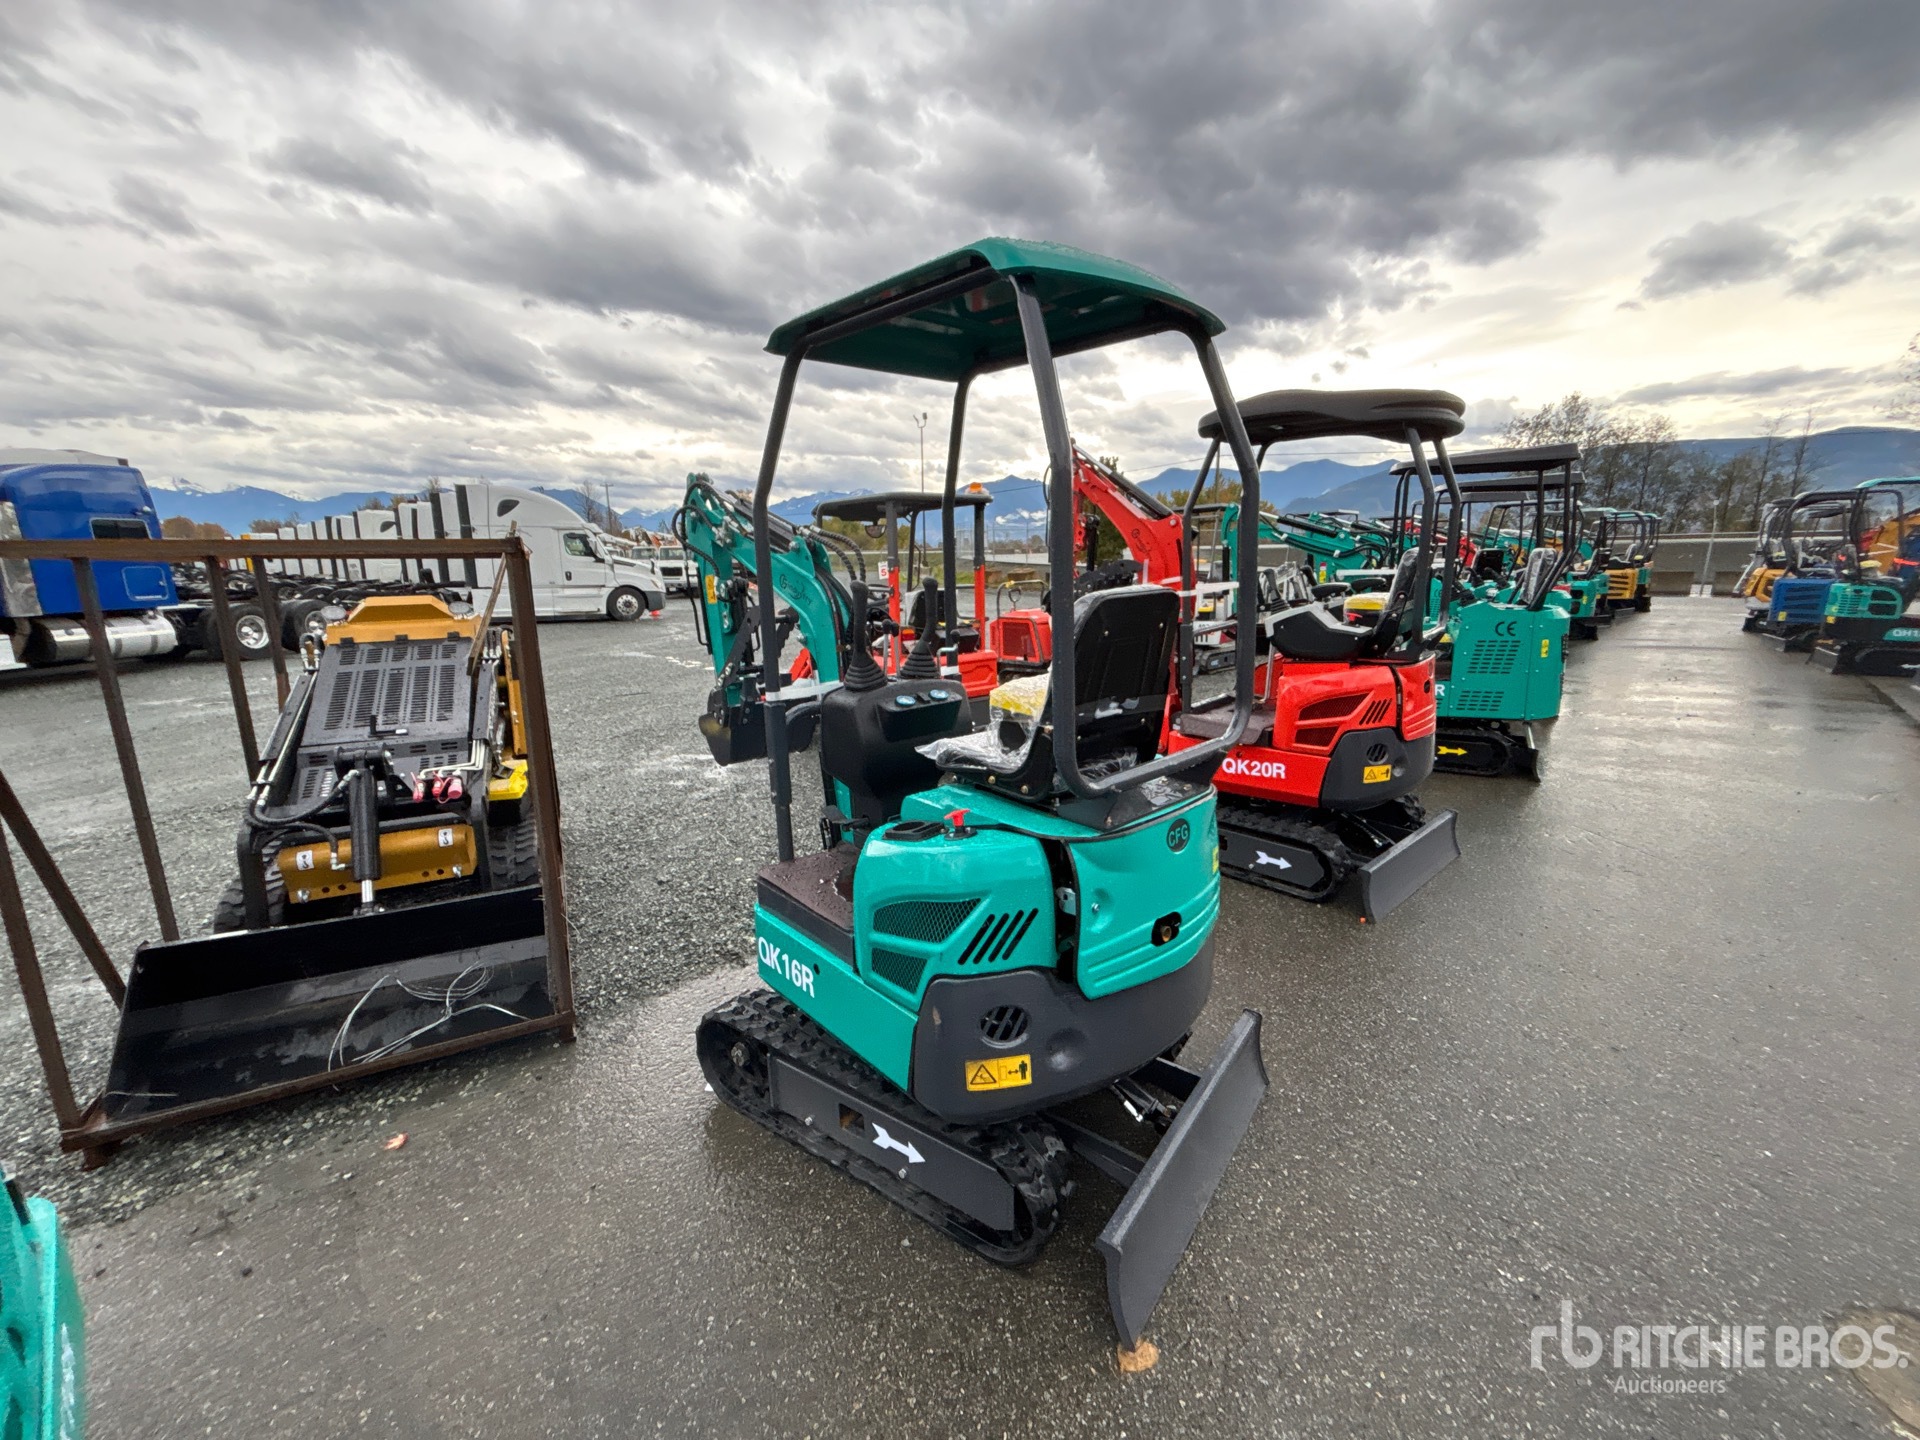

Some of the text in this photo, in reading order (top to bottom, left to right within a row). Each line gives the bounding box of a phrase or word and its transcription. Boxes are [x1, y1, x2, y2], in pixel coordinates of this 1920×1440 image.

[1495, 621, 1517, 636] CE
[1222, 758, 1286, 779] QK20R
[1169, 824, 1188, 847] CFG
[758, 936, 815, 998] QK16R
